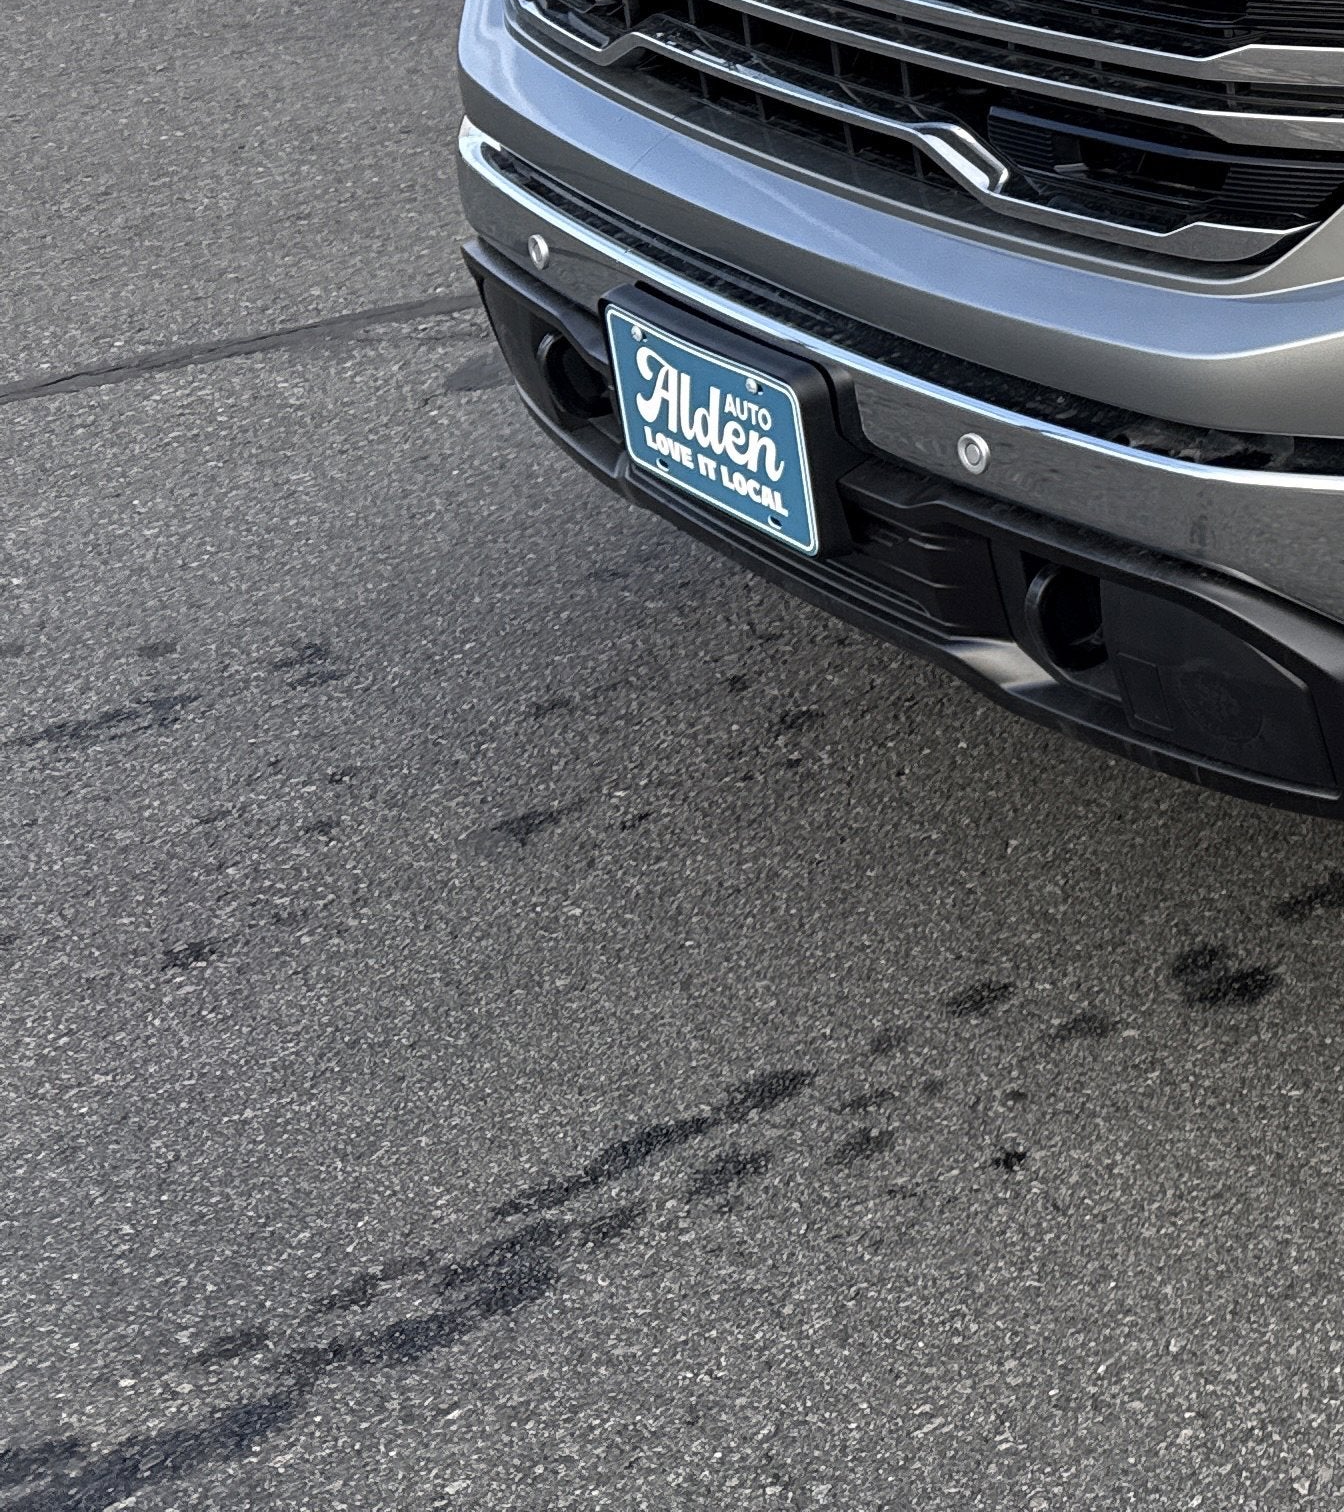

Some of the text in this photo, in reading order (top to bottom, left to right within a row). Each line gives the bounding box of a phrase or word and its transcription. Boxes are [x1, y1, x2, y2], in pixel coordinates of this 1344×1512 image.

[636, 346, 785, 482] Alden
[724, 393, 772, 431] AUTO
[644, 425, 789, 518] LOVE IT LOCAL
